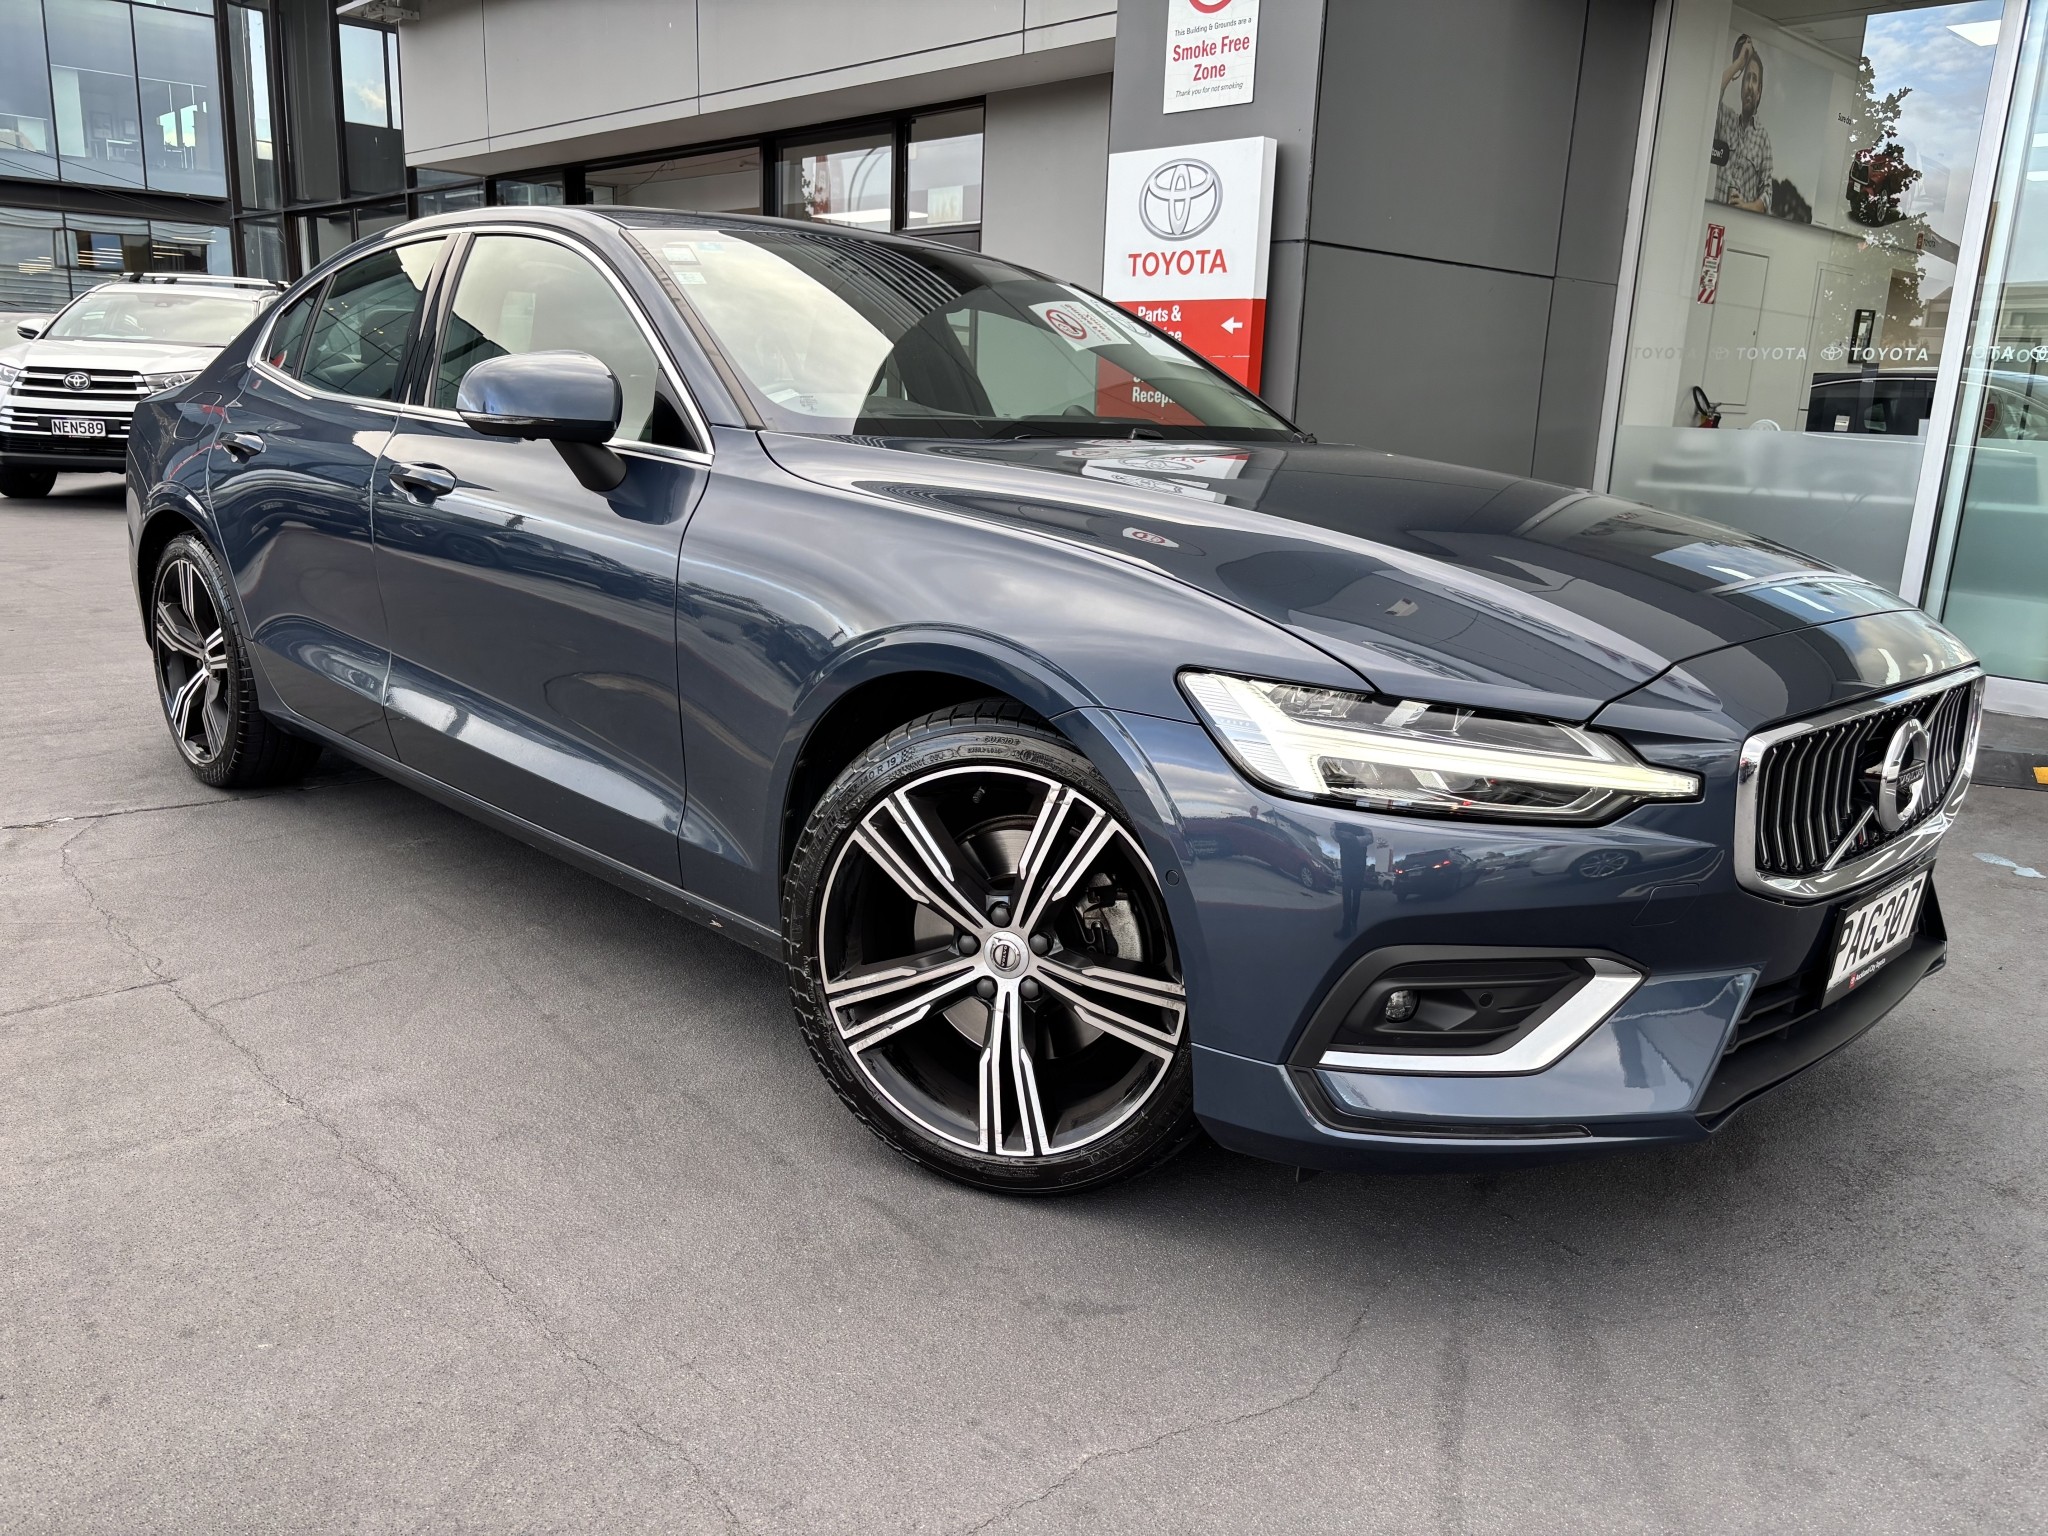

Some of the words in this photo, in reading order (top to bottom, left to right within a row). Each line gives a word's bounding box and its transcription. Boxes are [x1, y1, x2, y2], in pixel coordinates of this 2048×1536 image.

[1174, 29, 1186, 37] This
[1186, 25, 1208, 35] Building
[1208, 23, 1213, 31] &
[1214, 20, 1237, 30] Grounds
[1172, 39, 1217, 62] Smoke
[1220, 35, 1250, 54] Free
[1192, 63, 1226, 82] Zone
[1175, 88, 1191, 98] Thank
[1191, 88, 1201, 96] you
[1220, 81, 1244, 92] smoking
[1128, 249, 1228, 277] TOYOTA
[1137, 305, 1169, 322] Parts
[1171, 304, 1182, 322] &
[1736, 347, 1807, 360] TOYOTA
[1851, 347, 1929, 361] TOYOTA
[53, 421, 104, 434] NEN589
[887, 757, 896, 768] 19
[1838, 878, 1923, 972] PAG307
